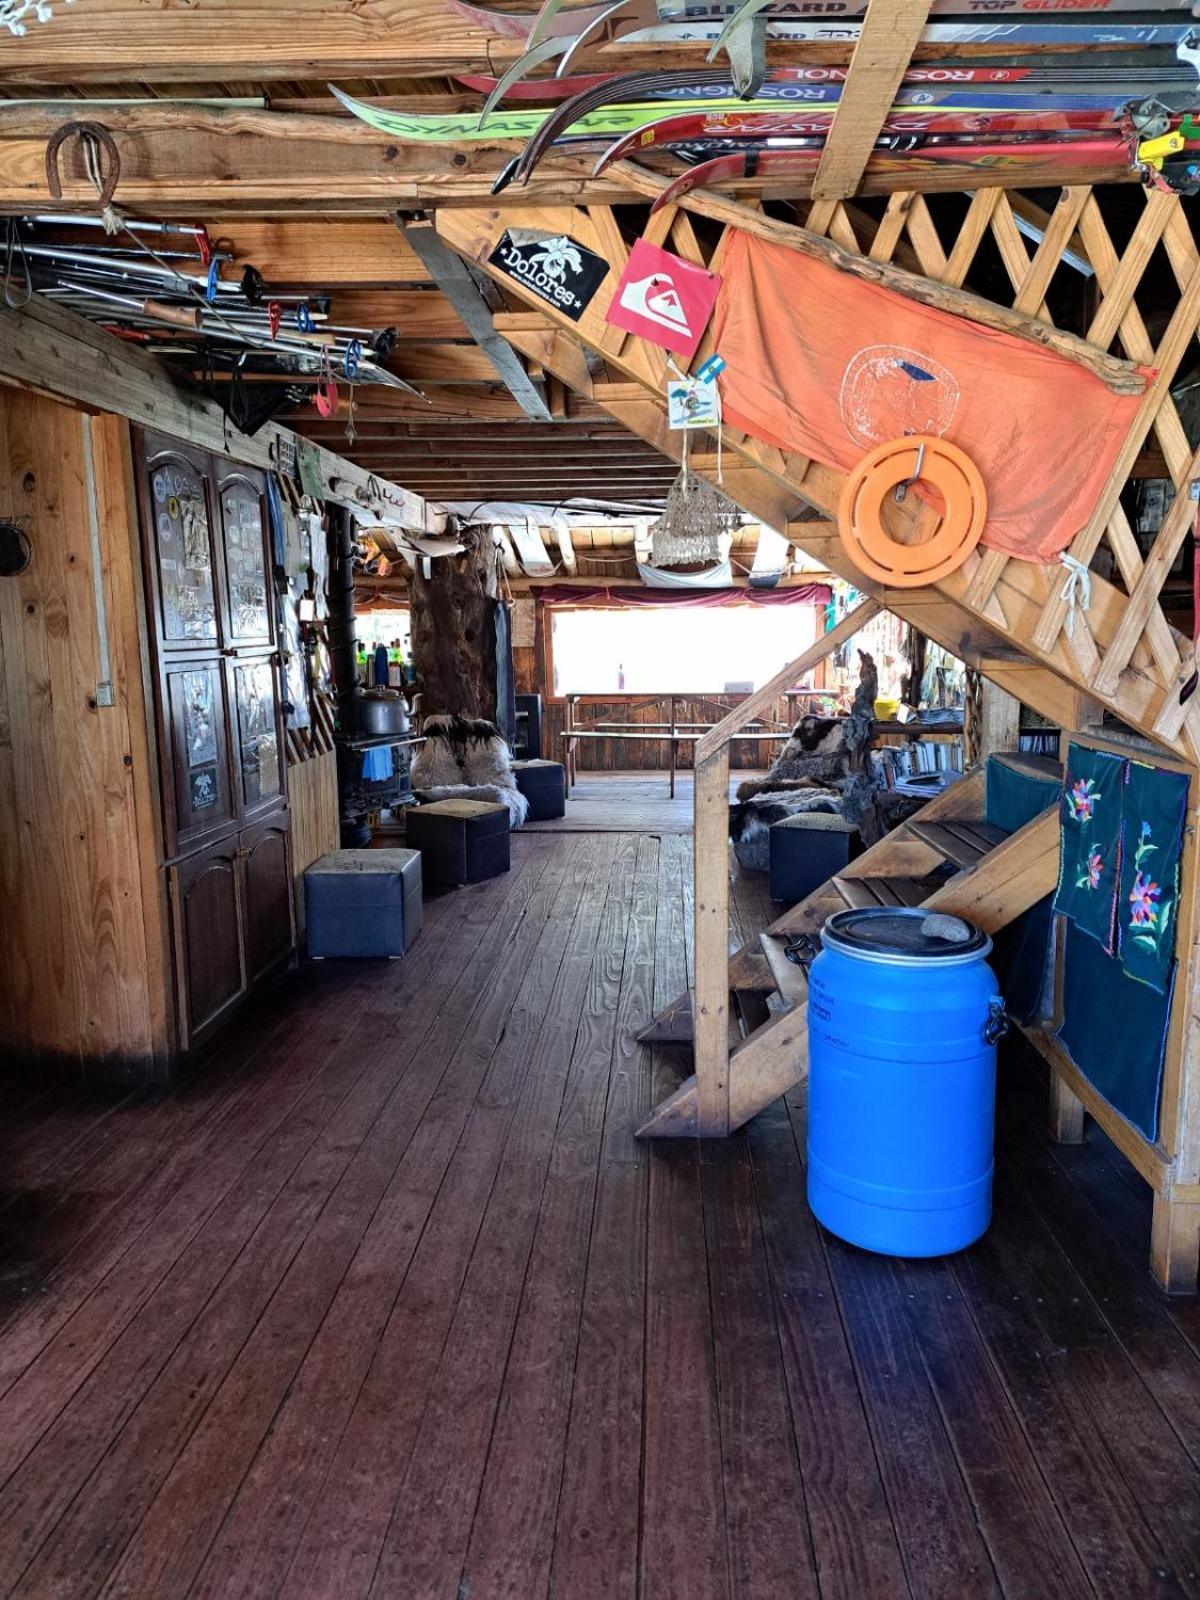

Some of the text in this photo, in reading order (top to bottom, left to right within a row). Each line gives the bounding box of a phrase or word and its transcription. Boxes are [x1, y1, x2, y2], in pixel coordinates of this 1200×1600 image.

[685, 2, 847, 17] BLIZARD
[970, 0, 1112, 10] TOP GLIDER
[504, 247, 576, 306] Dolores
